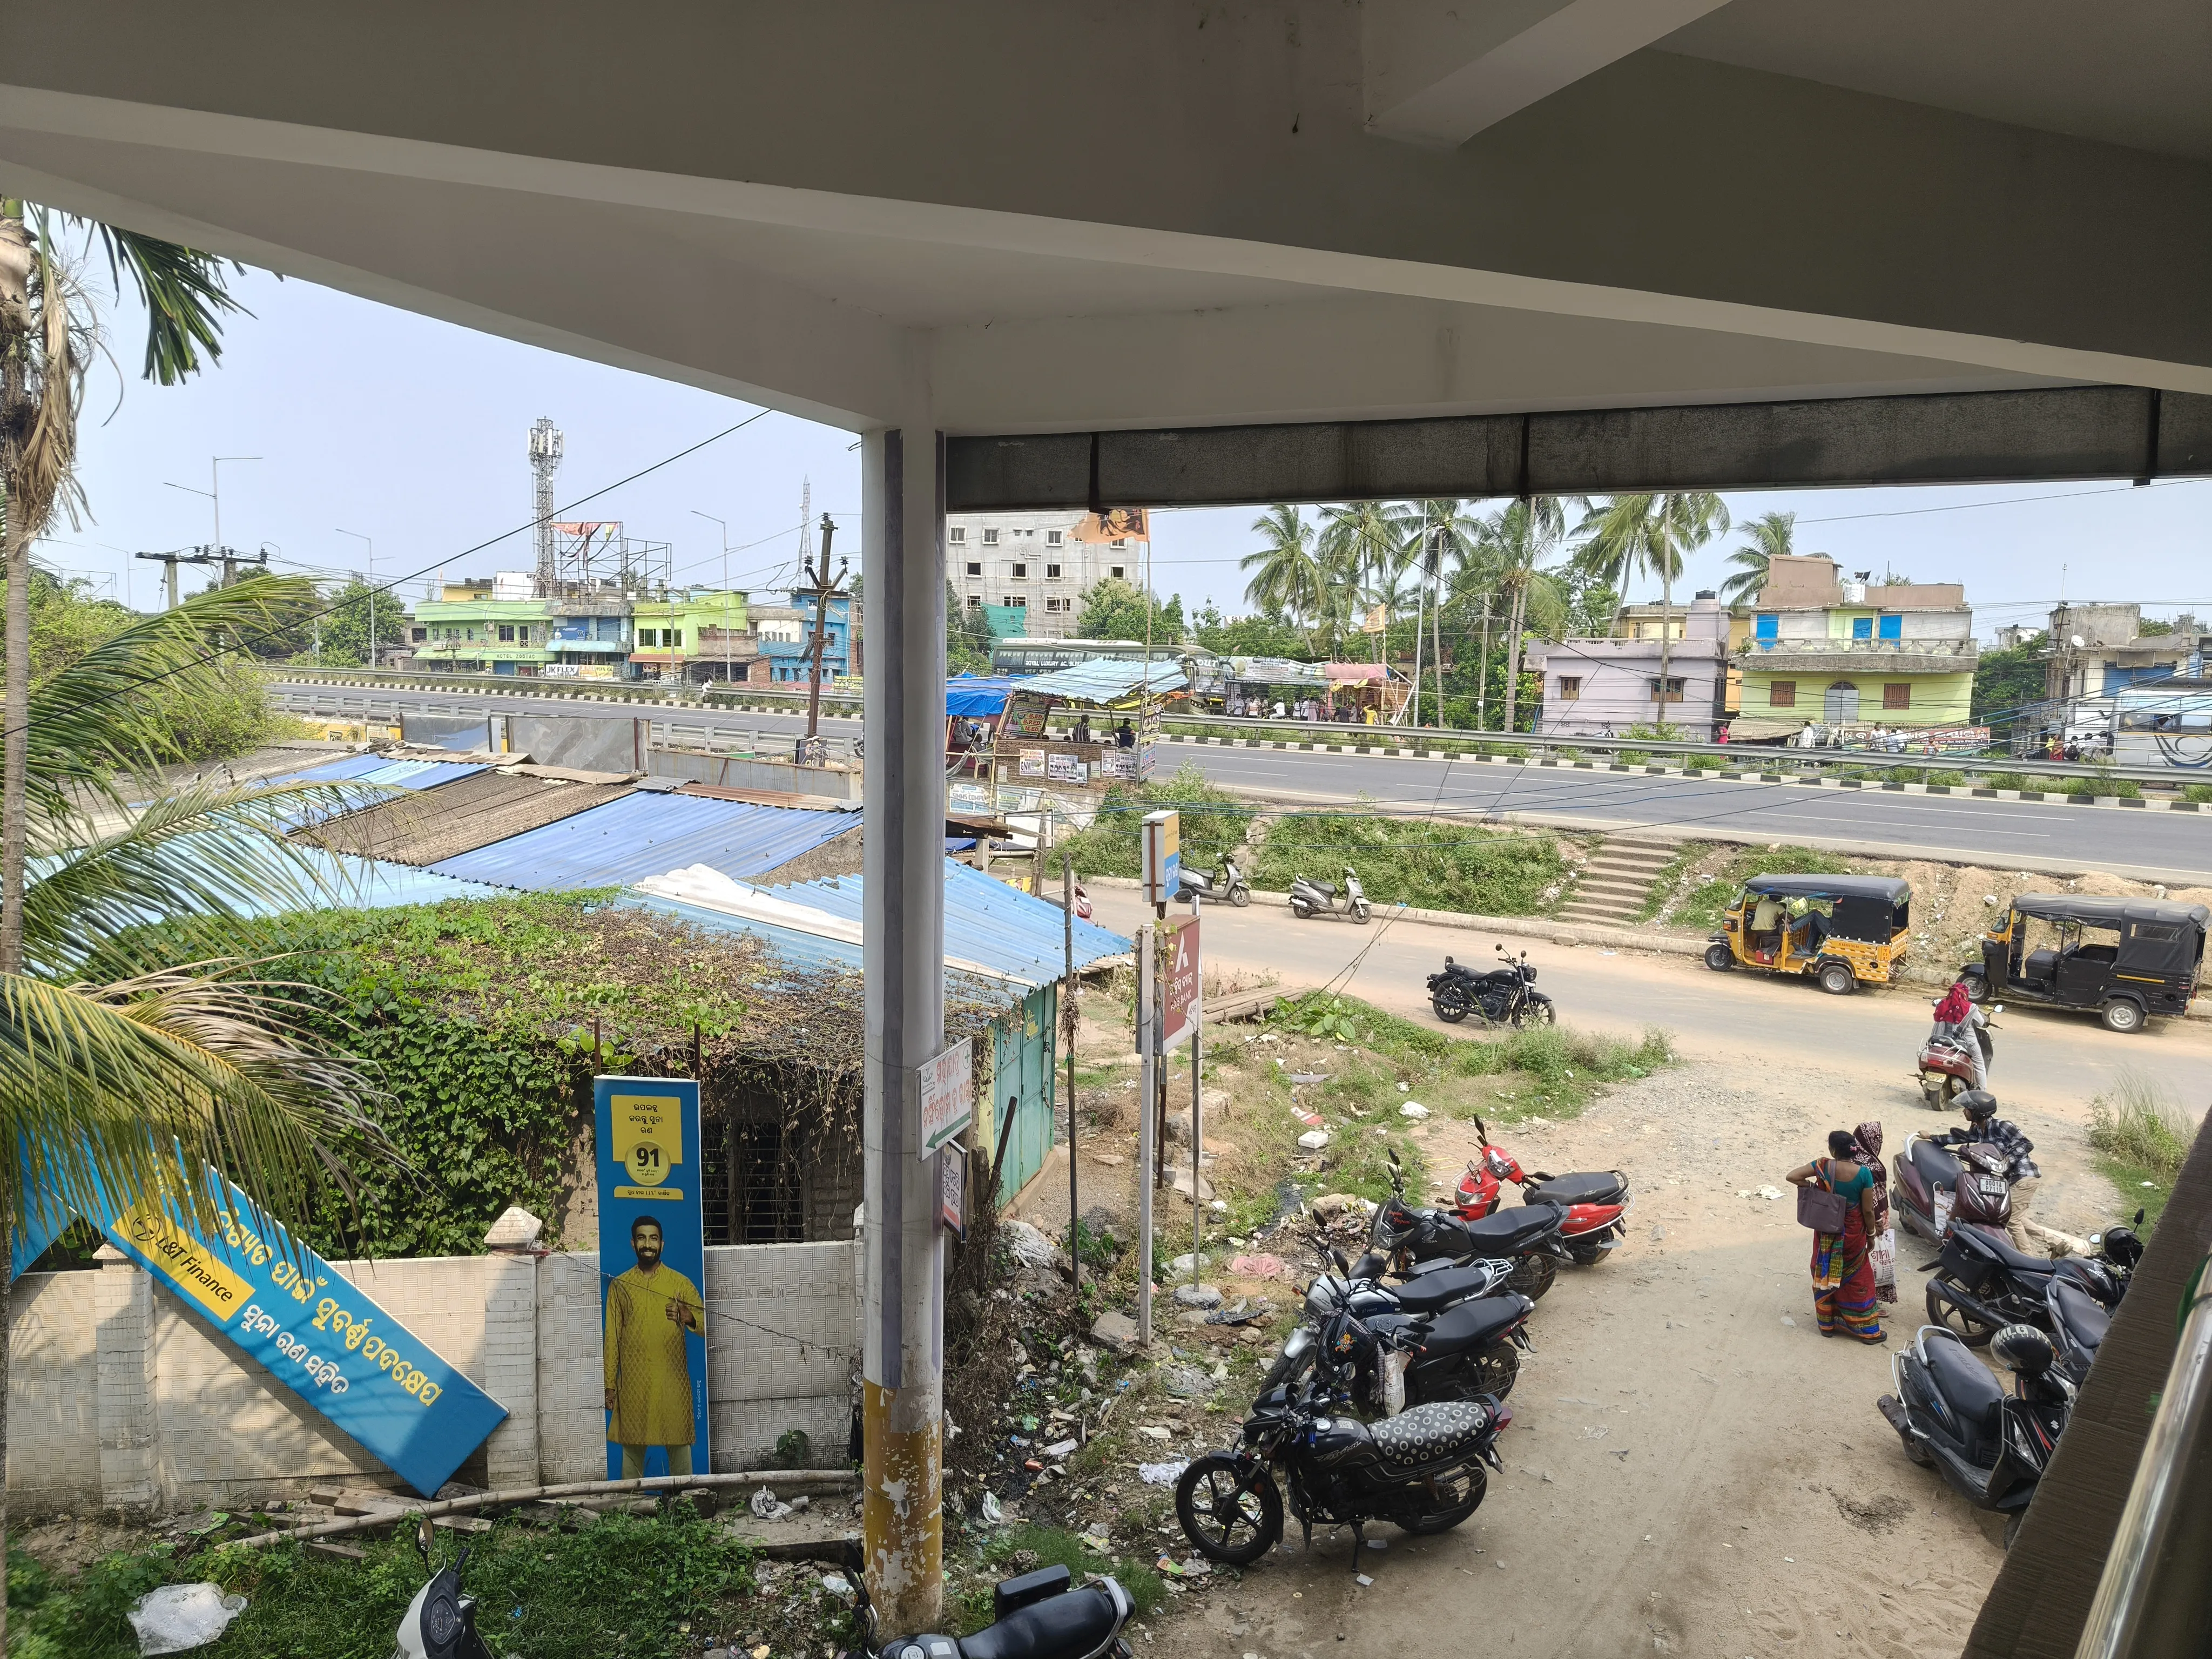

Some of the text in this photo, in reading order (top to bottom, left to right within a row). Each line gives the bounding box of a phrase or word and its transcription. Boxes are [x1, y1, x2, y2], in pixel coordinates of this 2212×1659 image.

[1181, 989, 1192, 1004] BANK
[636, 1147, 659, 1167] 91
[155, 1235, 233, 1302] L&T Finance
[240, 1304, 281, 1338] ସୁନା
[304, 1355, 349, 1393] ସହିତ
